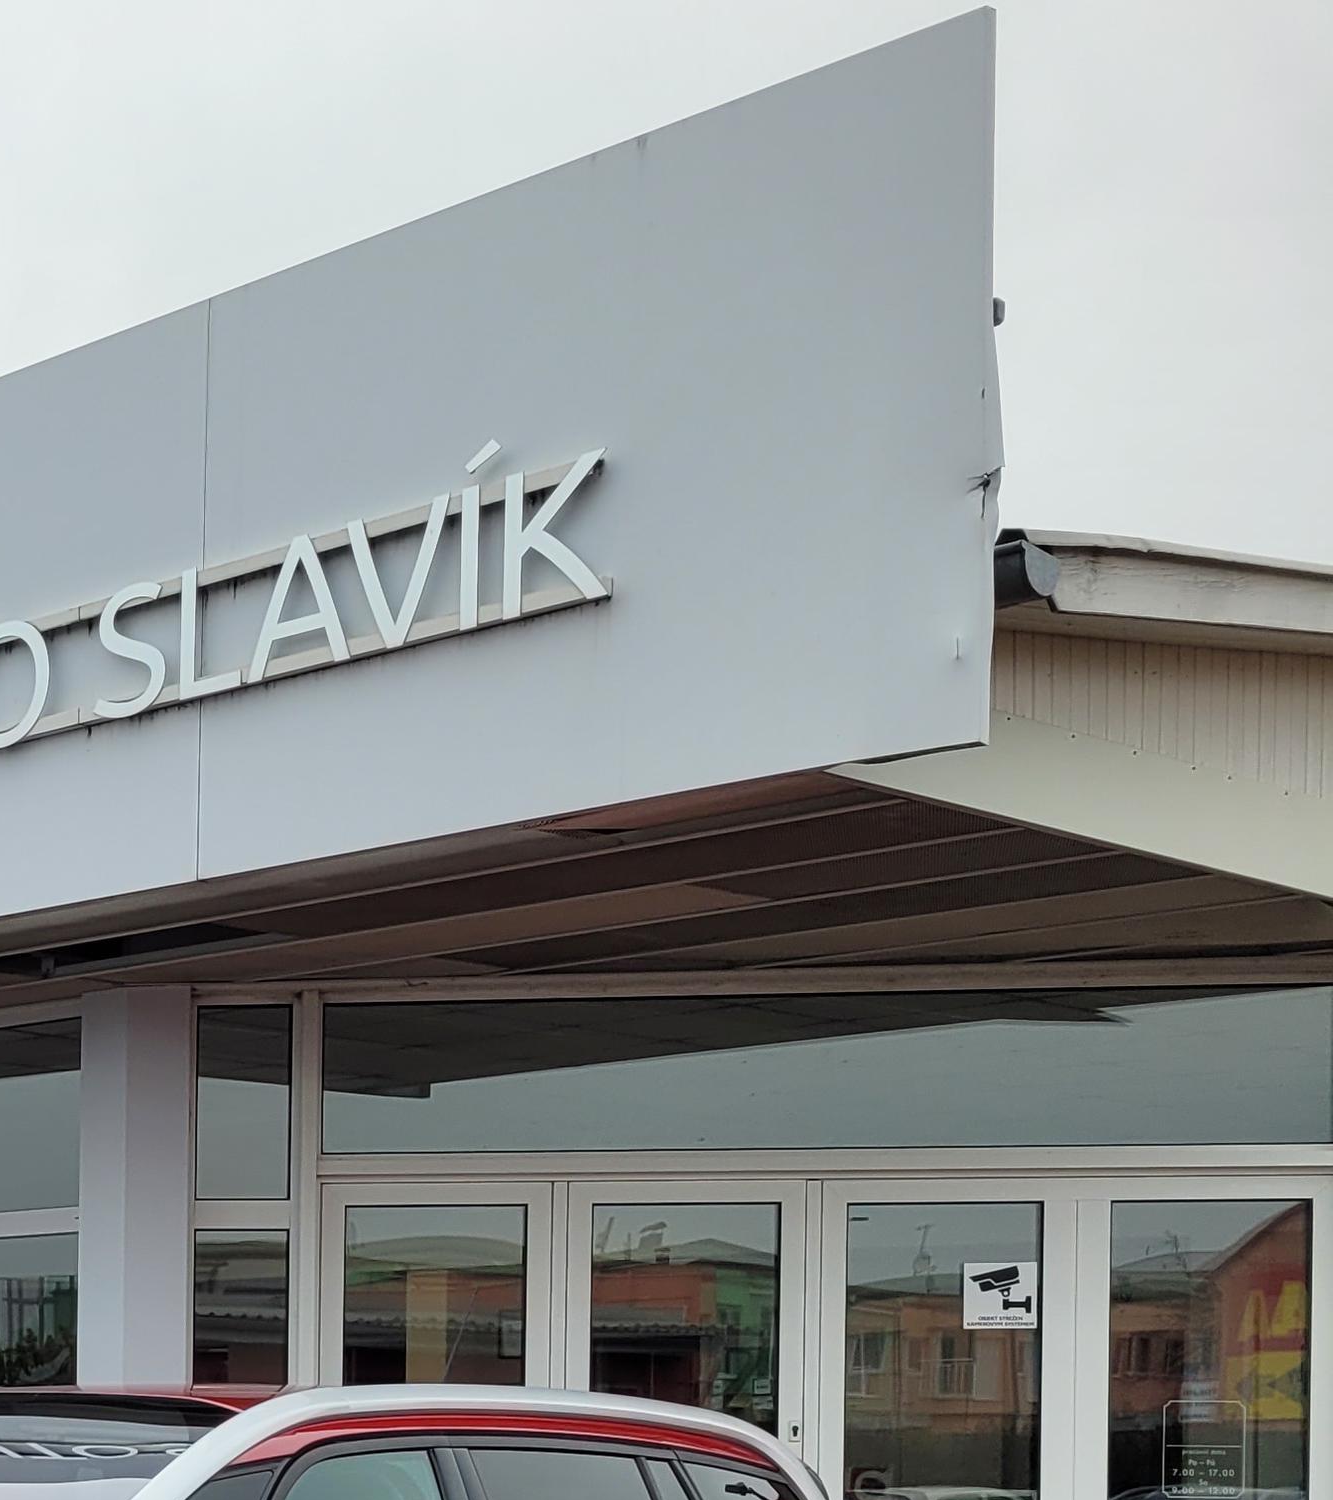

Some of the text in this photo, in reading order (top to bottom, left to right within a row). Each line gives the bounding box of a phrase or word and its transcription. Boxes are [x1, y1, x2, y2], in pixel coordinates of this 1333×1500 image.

[92, 439, 611, 719] SLAVÍK
[1172, 1468, 1195, 1477] 7.00
[1208, 1468, 1235, 1477] 17.00
[1171, 1486, 1195, 1495] 9.00
[1209, 1486, 1235, 1495] 12.00
